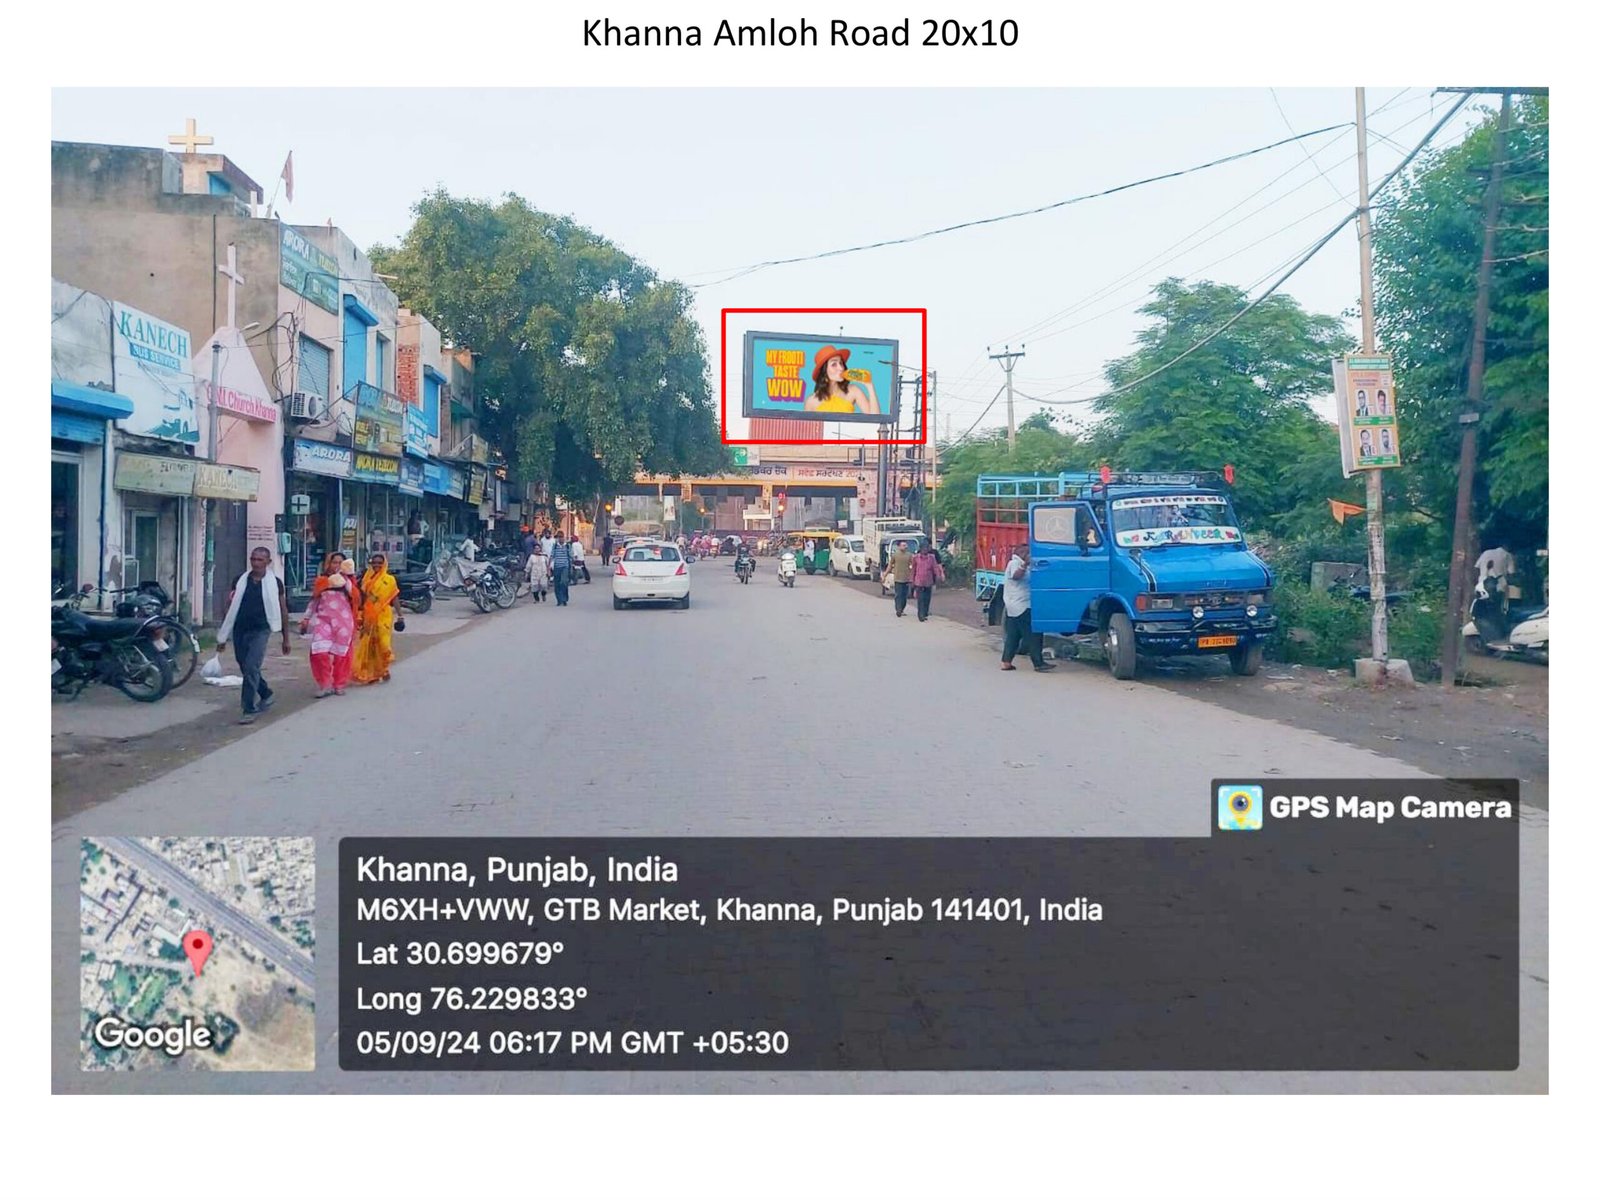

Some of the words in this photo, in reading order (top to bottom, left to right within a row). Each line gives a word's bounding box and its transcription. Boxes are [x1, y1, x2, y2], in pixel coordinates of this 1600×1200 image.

[283, 229, 310, 260] ARORA
[121, 310, 188, 358] KANECH
[765, 350, 779, 364] MY
[779, 350, 805, 366] FROOTI
[773, 366, 800, 379] TASTE
[766, 378, 804, 398] WOW
[229, 391, 254, 414] Church
[255, 399, 277, 422] Khanna
[311, 446, 351, 463] ARORA
